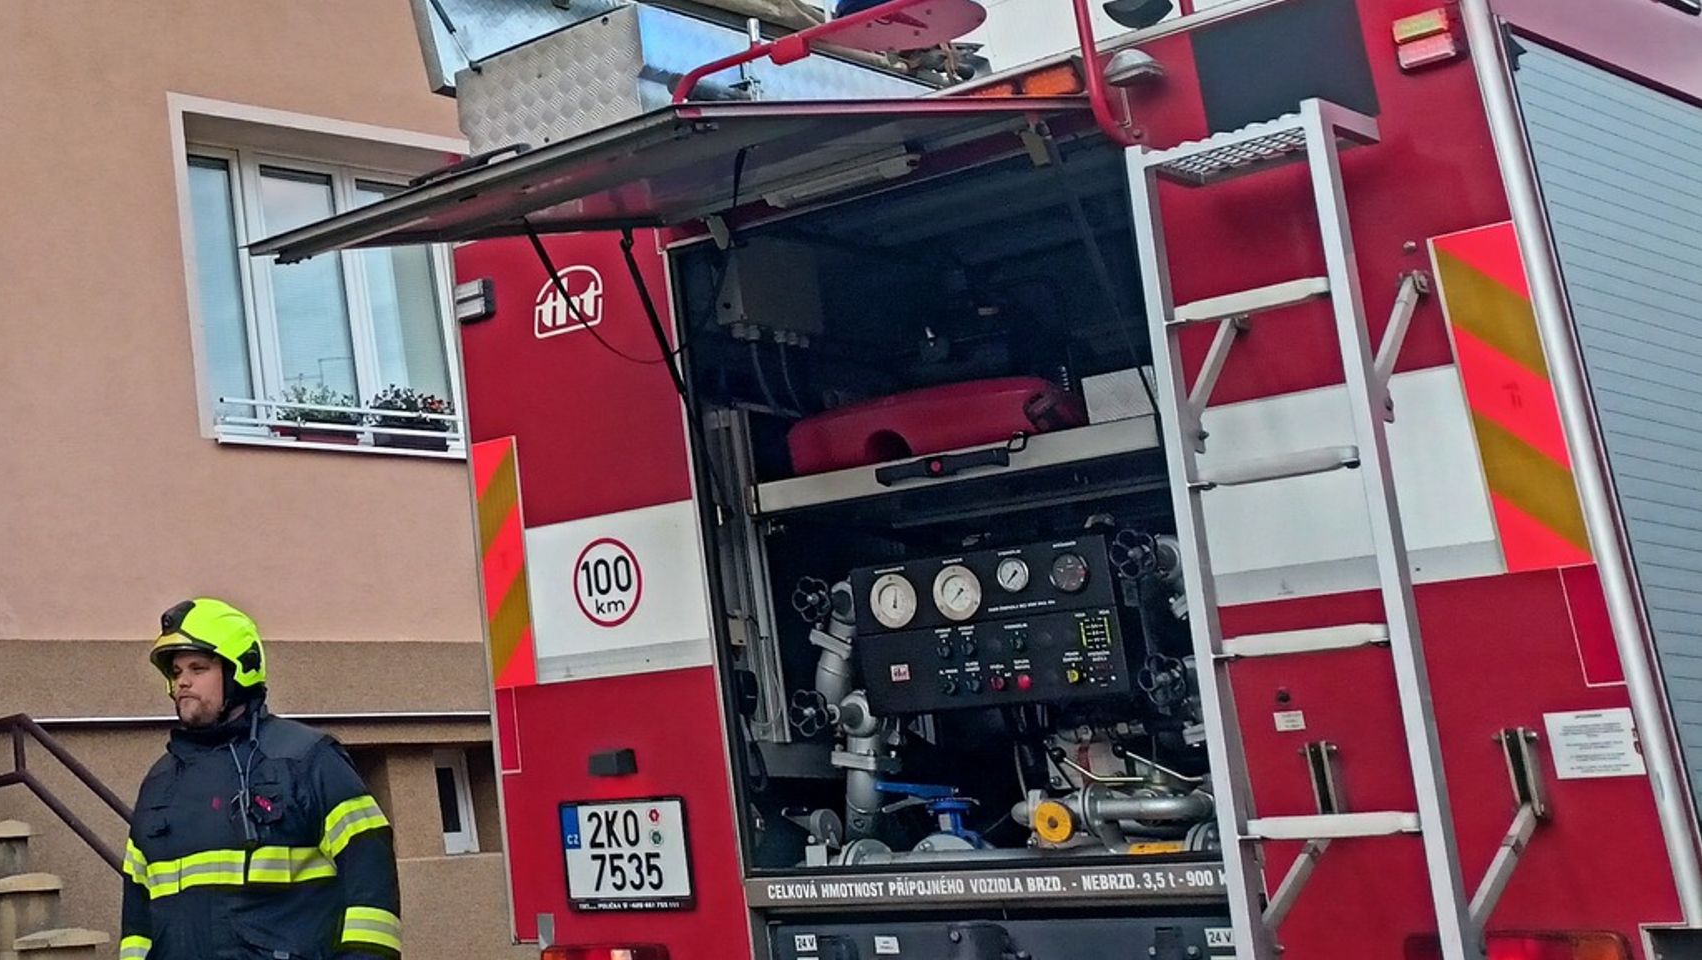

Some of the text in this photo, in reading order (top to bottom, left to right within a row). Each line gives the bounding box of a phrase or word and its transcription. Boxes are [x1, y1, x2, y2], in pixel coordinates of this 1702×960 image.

[580, 554, 632, 597] 100
[594, 598, 626, 615] km
[566, 833, 579, 845] CZ
[590, 852, 664, 892] 7535
[767, 879, 818, 900] CELKOVÁ
[821, 881, 884, 899] HMOTNOST
[888, 875, 964, 898] PŘÍPOJNÉHO
[970, 877, 1024, 895] VOZIDLA
[1026, 875, 1067, 892] BRZD.
[1082, 873, 1141, 891] NEBRZD.
[1143, 872, 1166, 892] 3,5
[1185, 870, 1214, 887] 900
